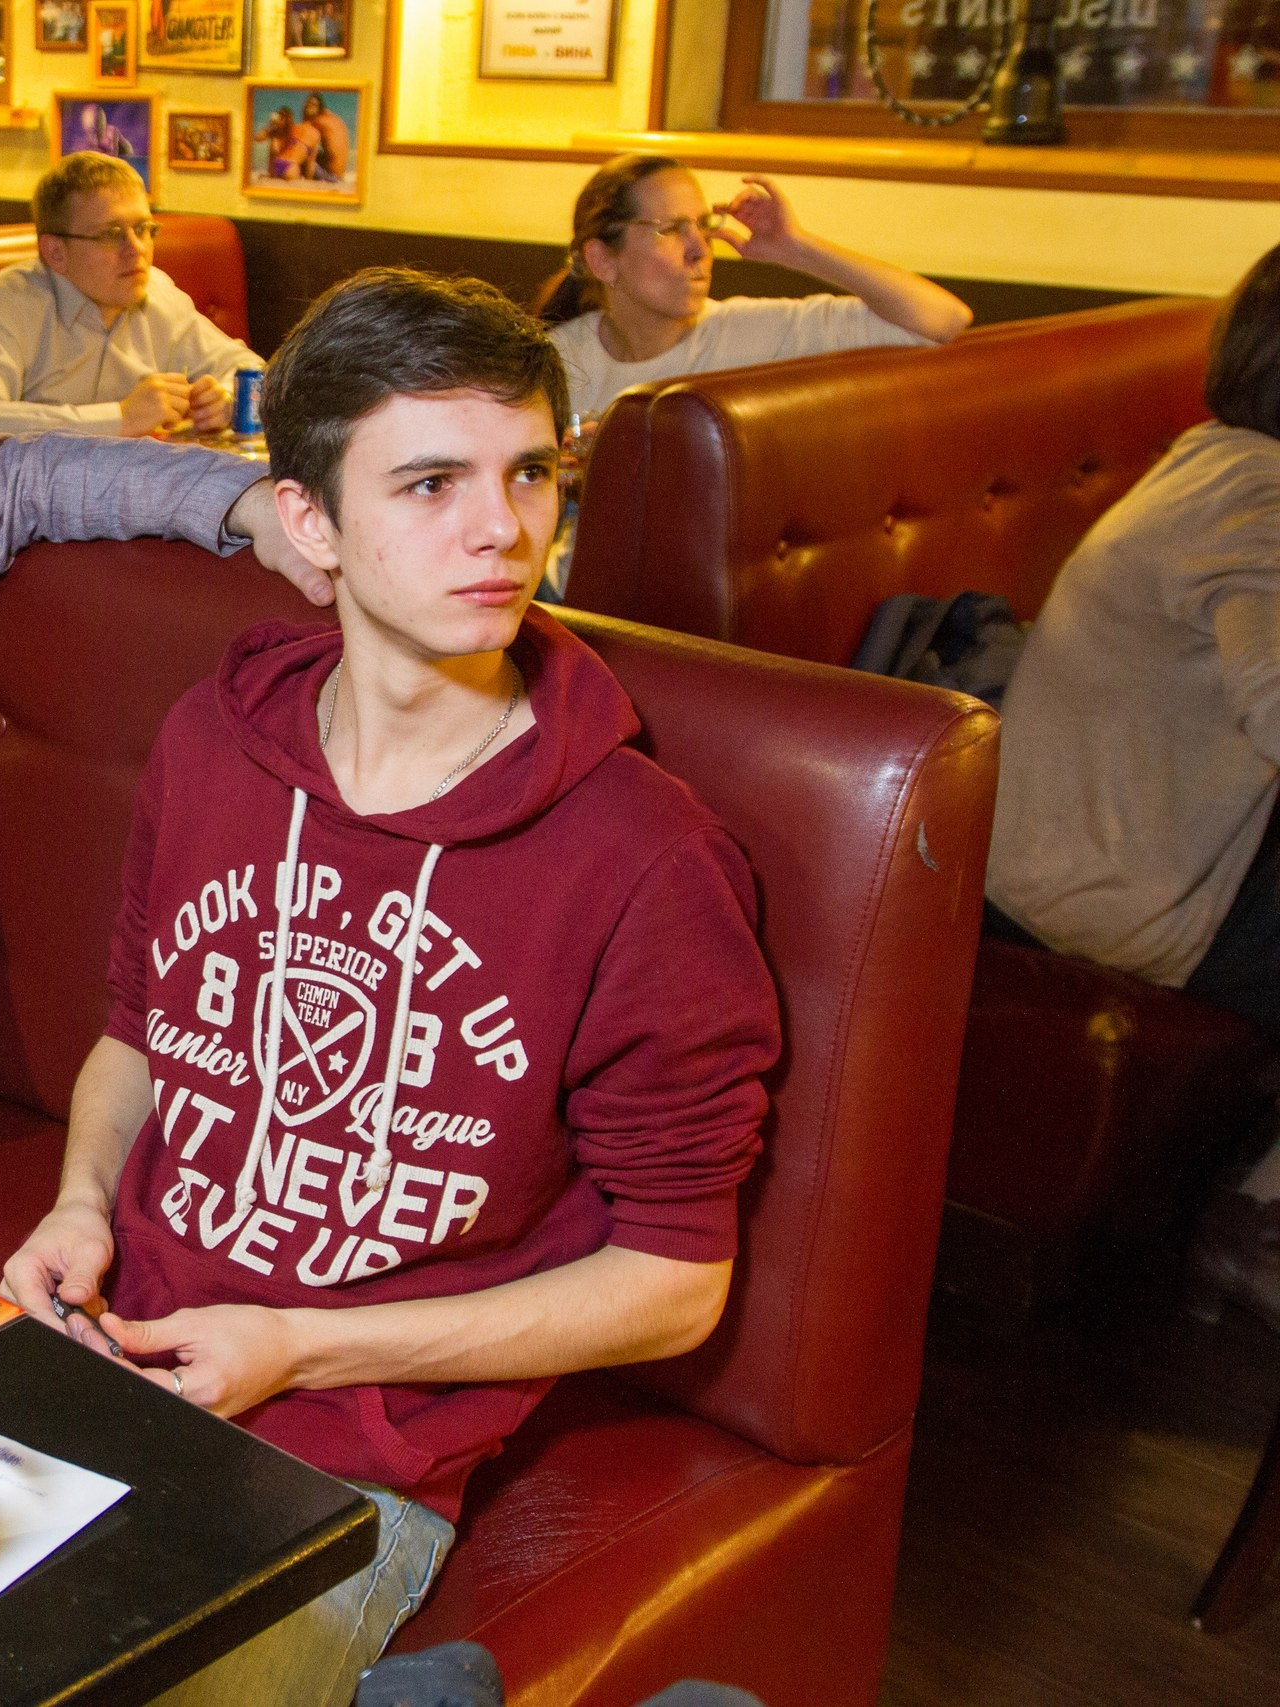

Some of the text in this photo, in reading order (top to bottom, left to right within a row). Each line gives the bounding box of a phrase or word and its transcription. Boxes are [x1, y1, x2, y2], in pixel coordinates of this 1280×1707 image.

[153, 864, 258, 980] LOOK
[368, 890, 483, 992] GET
[461, 995, 529, 1081] UP
[197, 951, 240, 1028] 8
[297, 982, 340, 1009] CHMPN
[298, 1002, 331, 1028] TEAM
[258, 1131, 490, 1245] NEVER
